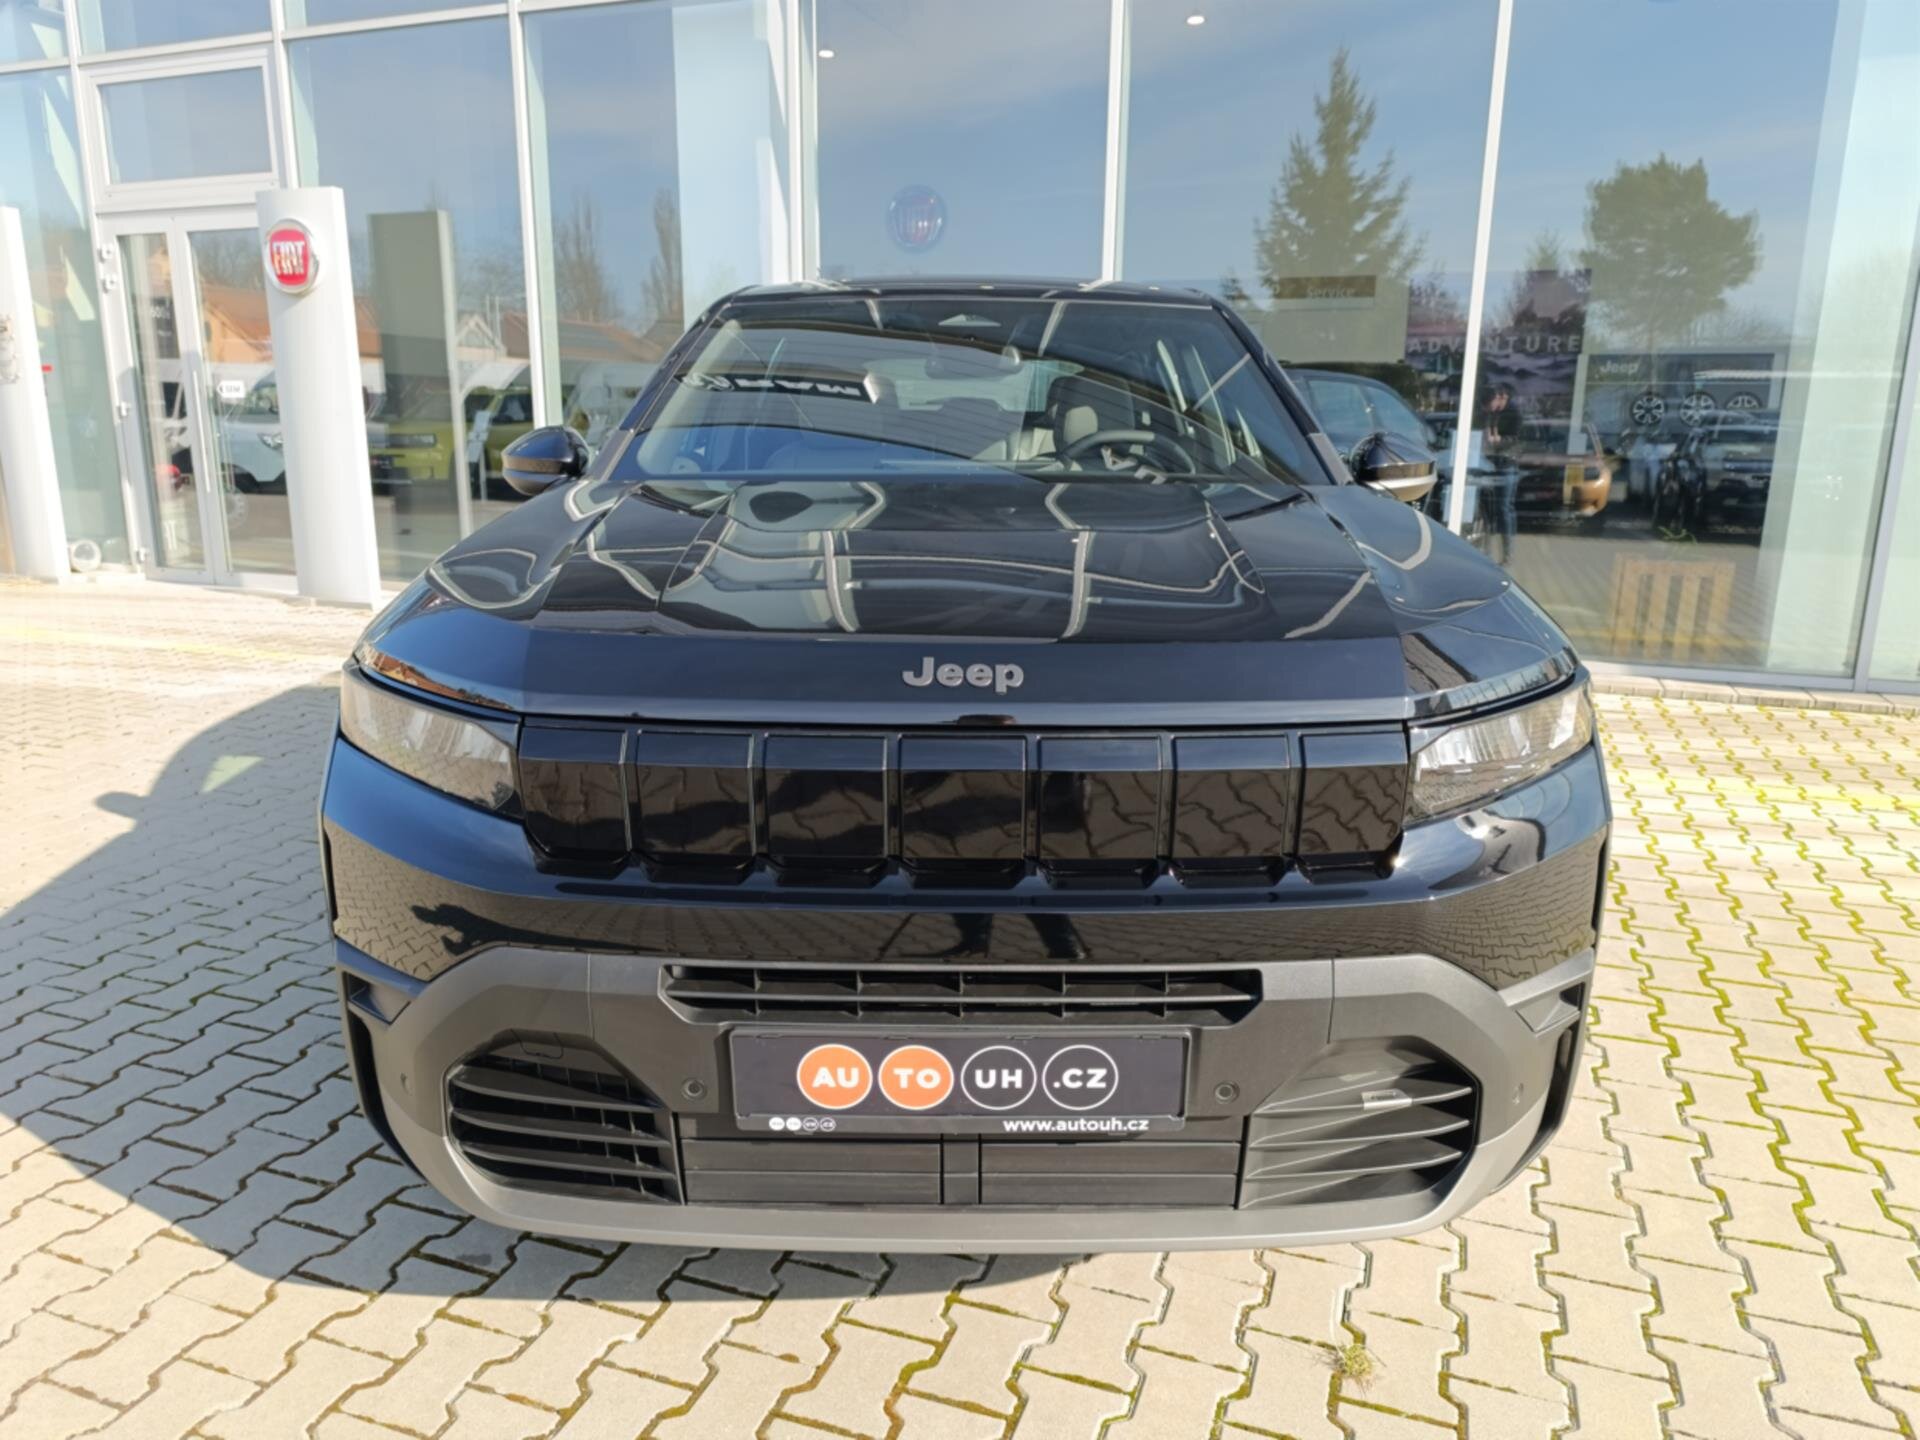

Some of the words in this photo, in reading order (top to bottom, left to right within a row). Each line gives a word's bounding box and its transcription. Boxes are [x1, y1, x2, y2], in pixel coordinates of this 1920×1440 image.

[271, 241, 304, 275] FIAT
[1408, 335, 1581, 353] ADVNTURE
[902, 657, 1024, 695] Jeep
[813, 1067, 859, 1087] AU
[893, 1069, 941, 1088] TO
[975, 1069, 1023, 1088] UH
[1053, 1069, 1107, 1088] .CZ
[1003, 1117, 1150, 1132] www.autouh.cz
